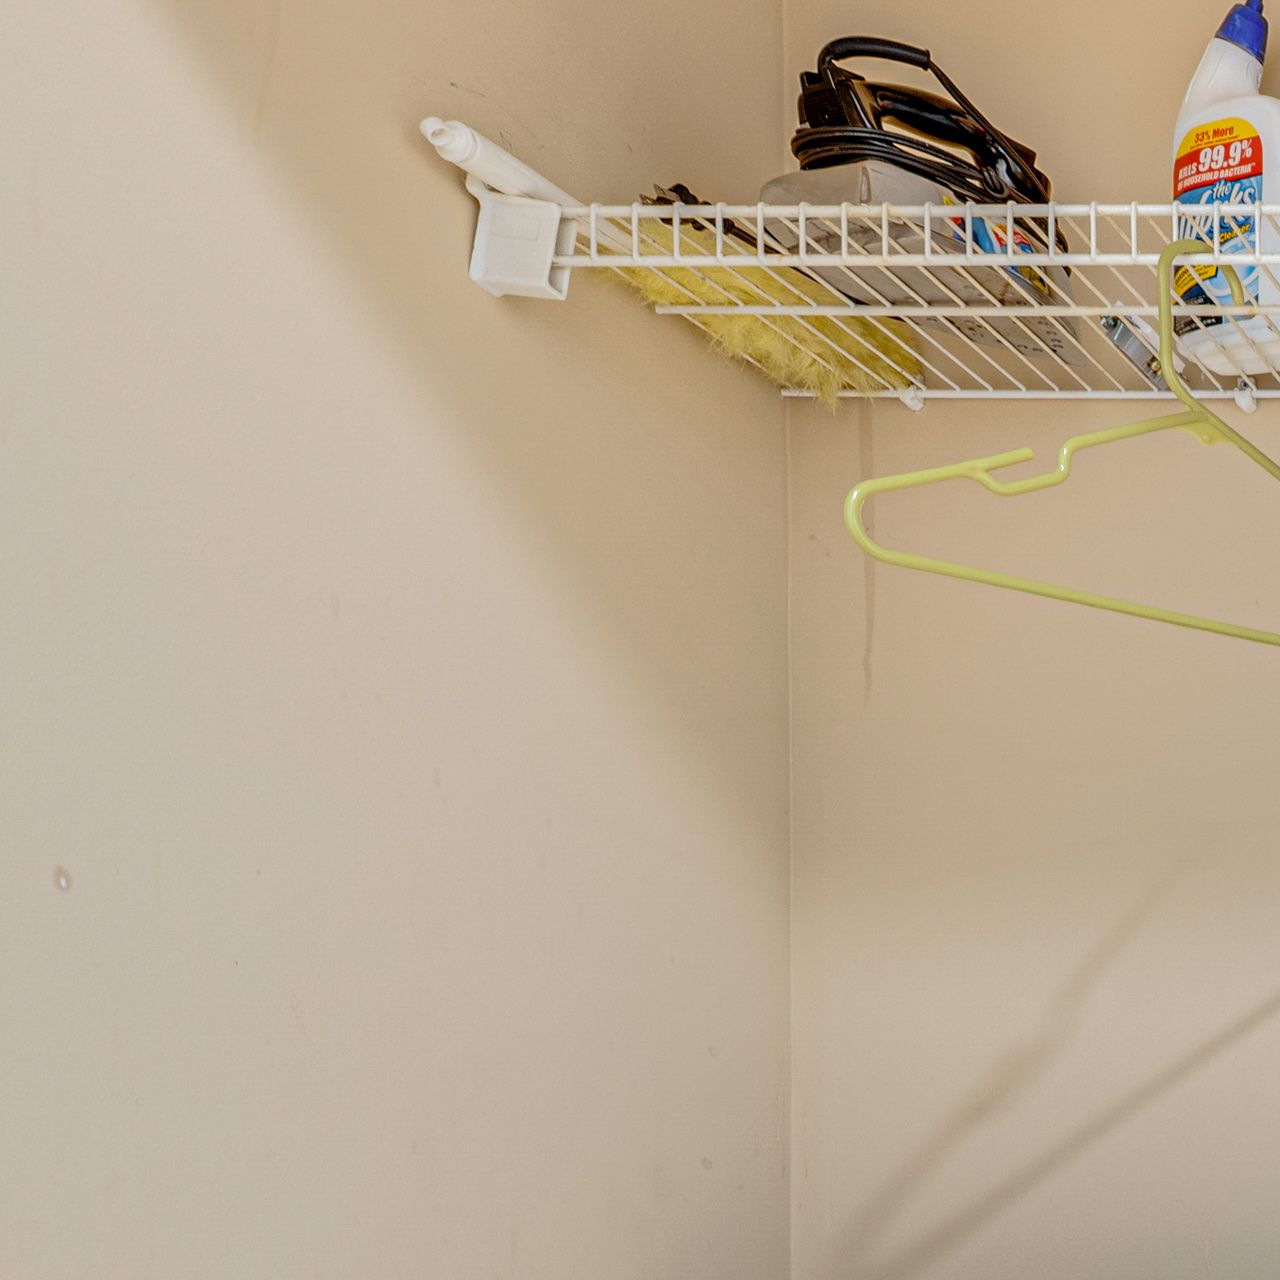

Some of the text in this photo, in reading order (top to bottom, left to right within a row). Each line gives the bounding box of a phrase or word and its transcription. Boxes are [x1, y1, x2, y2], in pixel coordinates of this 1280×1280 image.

[1212, 126, 1234, 139] More
[1198, 139, 1253, 172] 99.9%
[1213, 179, 1232, 200] the
